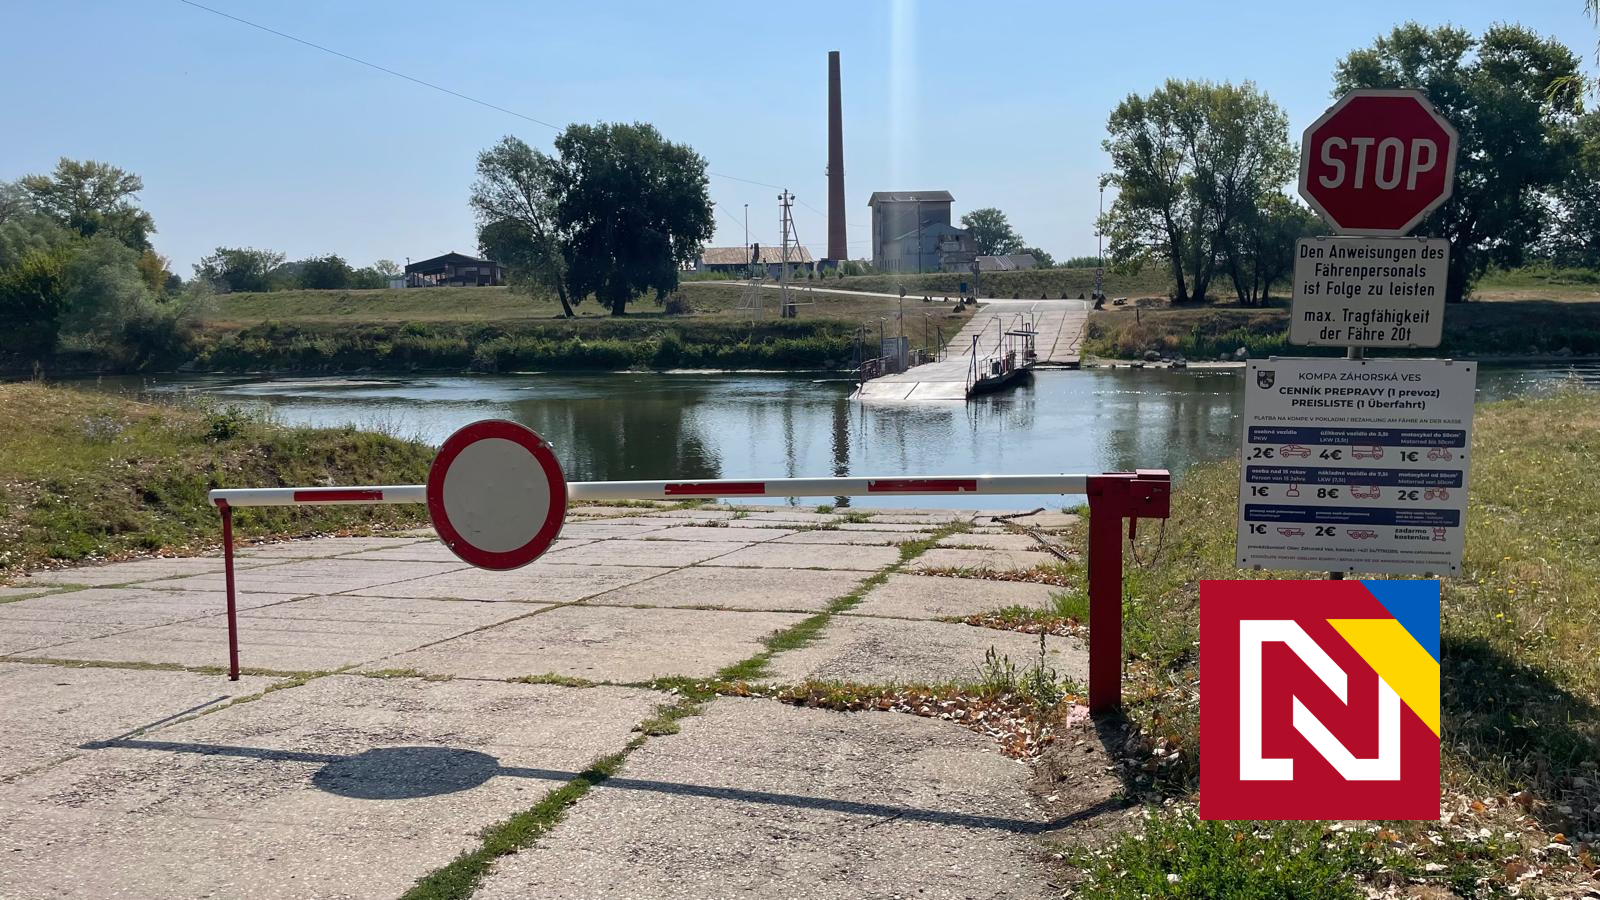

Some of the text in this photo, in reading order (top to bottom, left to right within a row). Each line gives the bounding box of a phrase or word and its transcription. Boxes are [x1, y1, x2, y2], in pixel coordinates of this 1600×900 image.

[1318, 136, 1438, 190] STOP
[1300, 245, 1444, 262] Den Anweisungen des
[1315, 263, 1426, 280] Fährenpersonals
[1304, 281, 1435, 298] ist Folge zu leisten
[1304, 308, 1430, 326] max. Tragfähigkeit
[1320, 326, 1412, 341] der Fähre 20t
[1298, 372, 1337, 381] KOMPA
[1340, 372, 1399, 381] ZÁHORSKÁ
[1279, 385, 1440, 398] CENNÍK PREPRAVY (1 prevoz)
[1292, 398, 1426, 410] PREISLISTE (1 Überfahrt)
[1253, 447, 1274, 459] 2€
[1320, 449, 1342, 460] 4€
[1400, 451, 1419, 462] 1€
[1251, 486, 1269, 496] 1€
[1317, 488, 1339, 499] 8€
[1398, 490, 1419, 500] 2€
[1249, 524, 1267, 534] 1€
[1315, 526, 1336, 536] 2€
